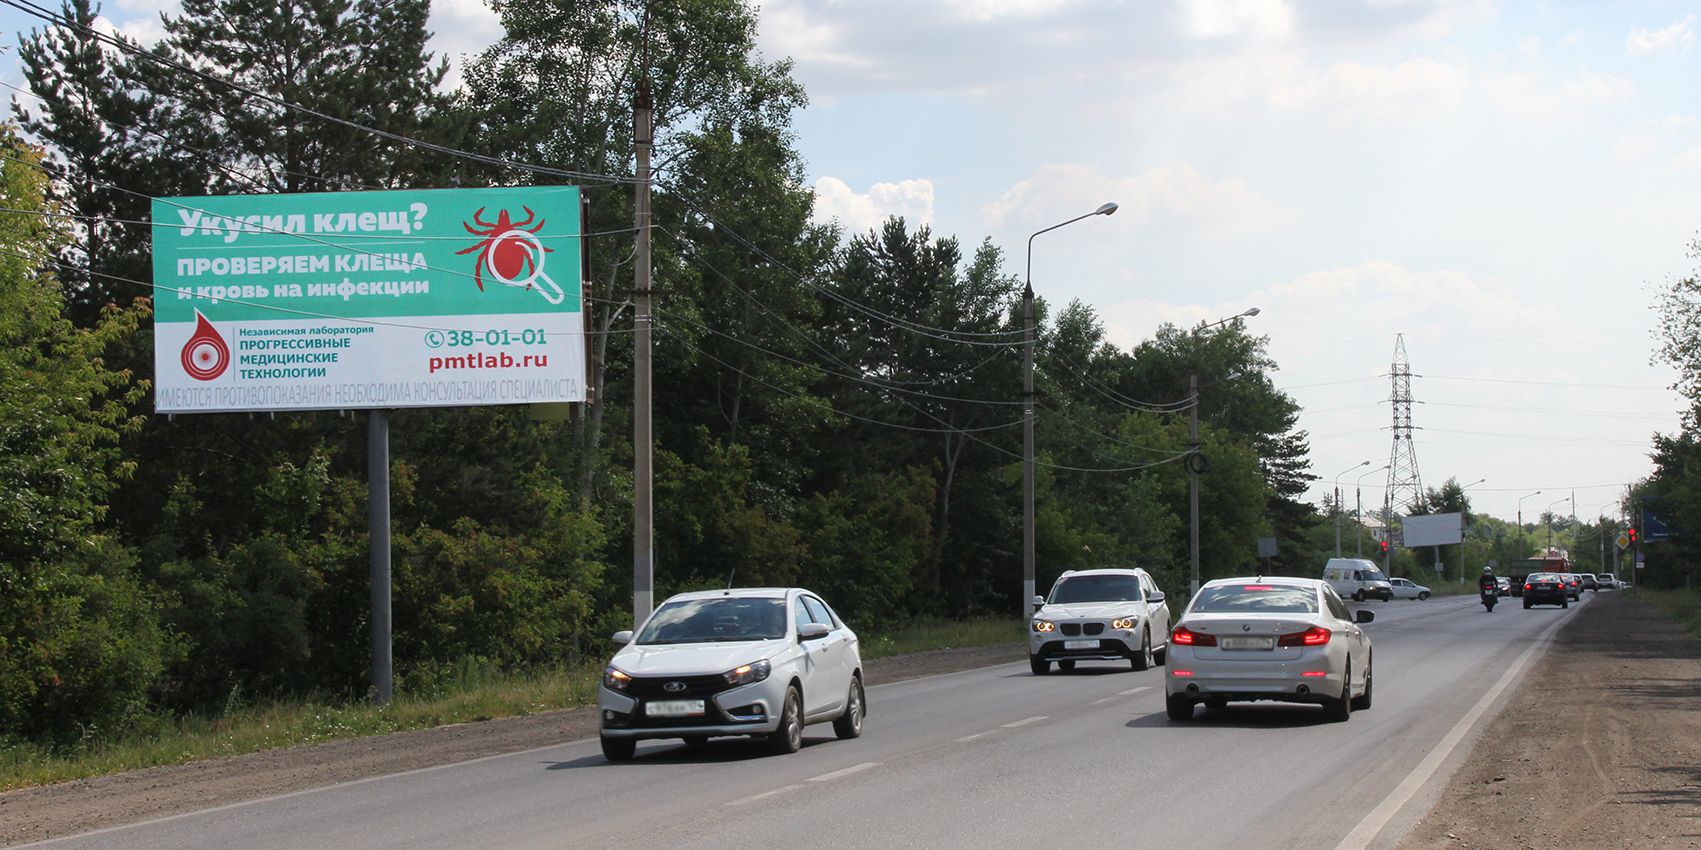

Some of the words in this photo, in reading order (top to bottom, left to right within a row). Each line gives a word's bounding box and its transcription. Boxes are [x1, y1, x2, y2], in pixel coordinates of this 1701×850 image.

[178, 209, 305, 243] Укусил
[314, 203, 428, 234] клещ?
[177, 255, 329, 276] ПРОВЕРЯЕМ
[334, 251, 428, 273] КЛЕЩА
[177, 286, 192, 300] и
[196, 283, 270, 304] кровь
[273, 283, 303, 298] на
[307, 277, 430, 302] инфекции
[239, 328, 307, 337] Независимая
[309, 326, 374, 336] лаборатория
[448, 329, 547, 347] 38-01-01
[240, 338, 350, 350] ПРОГРЕССИВНЫЕ
[239, 352, 339, 366] МЕДИЦИНСКИЕ
[429, 352, 548, 373] pmtlab.ru
[239, 367, 327, 380] ТЕХНОЛОГИИ
[157, 387, 212, 408] ИМЕЮТСЯ
[214, 384, 332, 406] ПРОТИВОПОКАЗАНИЯ
[334, 382, 412, 404] НЕОБХОДИМА
[414, 379, 497, 402] КОНСУЛЬТАЦИЯ
[500, 378, 578, 400] СПЕЦИАЛИСТА
